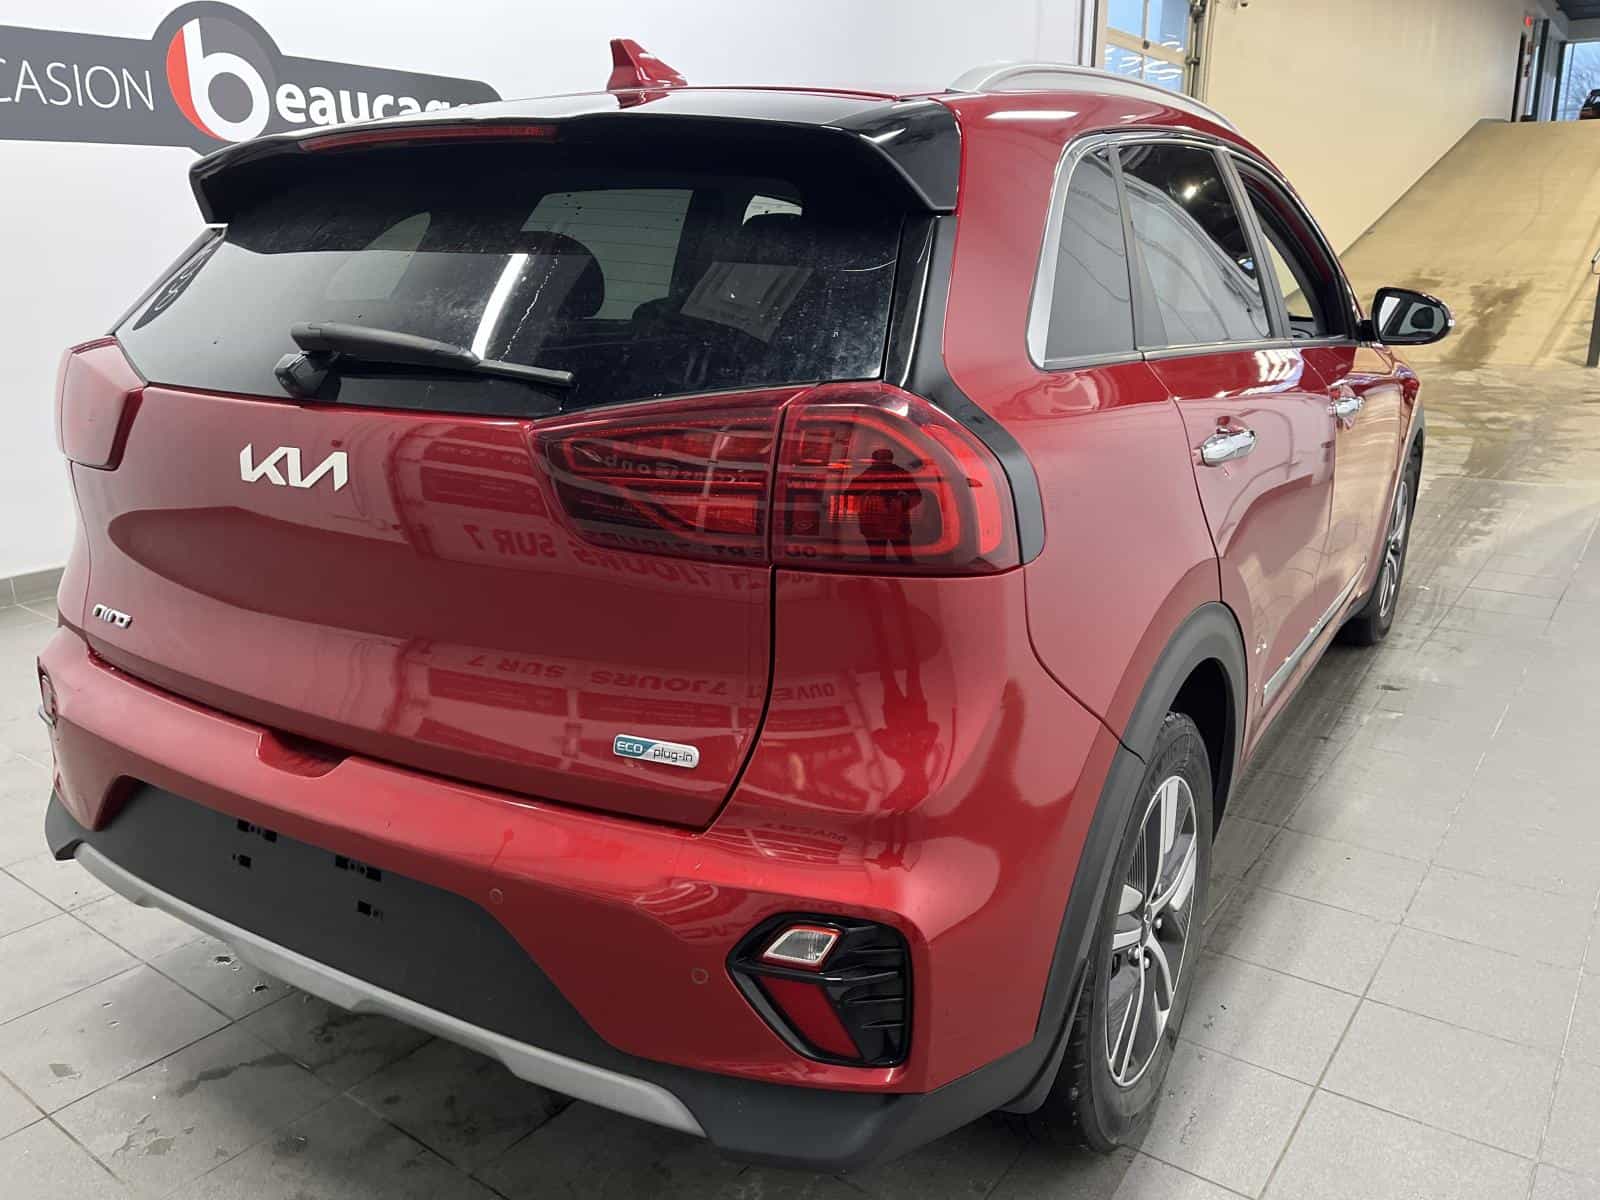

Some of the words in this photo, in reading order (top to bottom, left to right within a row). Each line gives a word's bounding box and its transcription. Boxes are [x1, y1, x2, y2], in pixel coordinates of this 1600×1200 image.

[239, 442, 348, 492] KIA
[616, 740, 644, 754] ECO
[653, 747, 694, 762] plug-in
